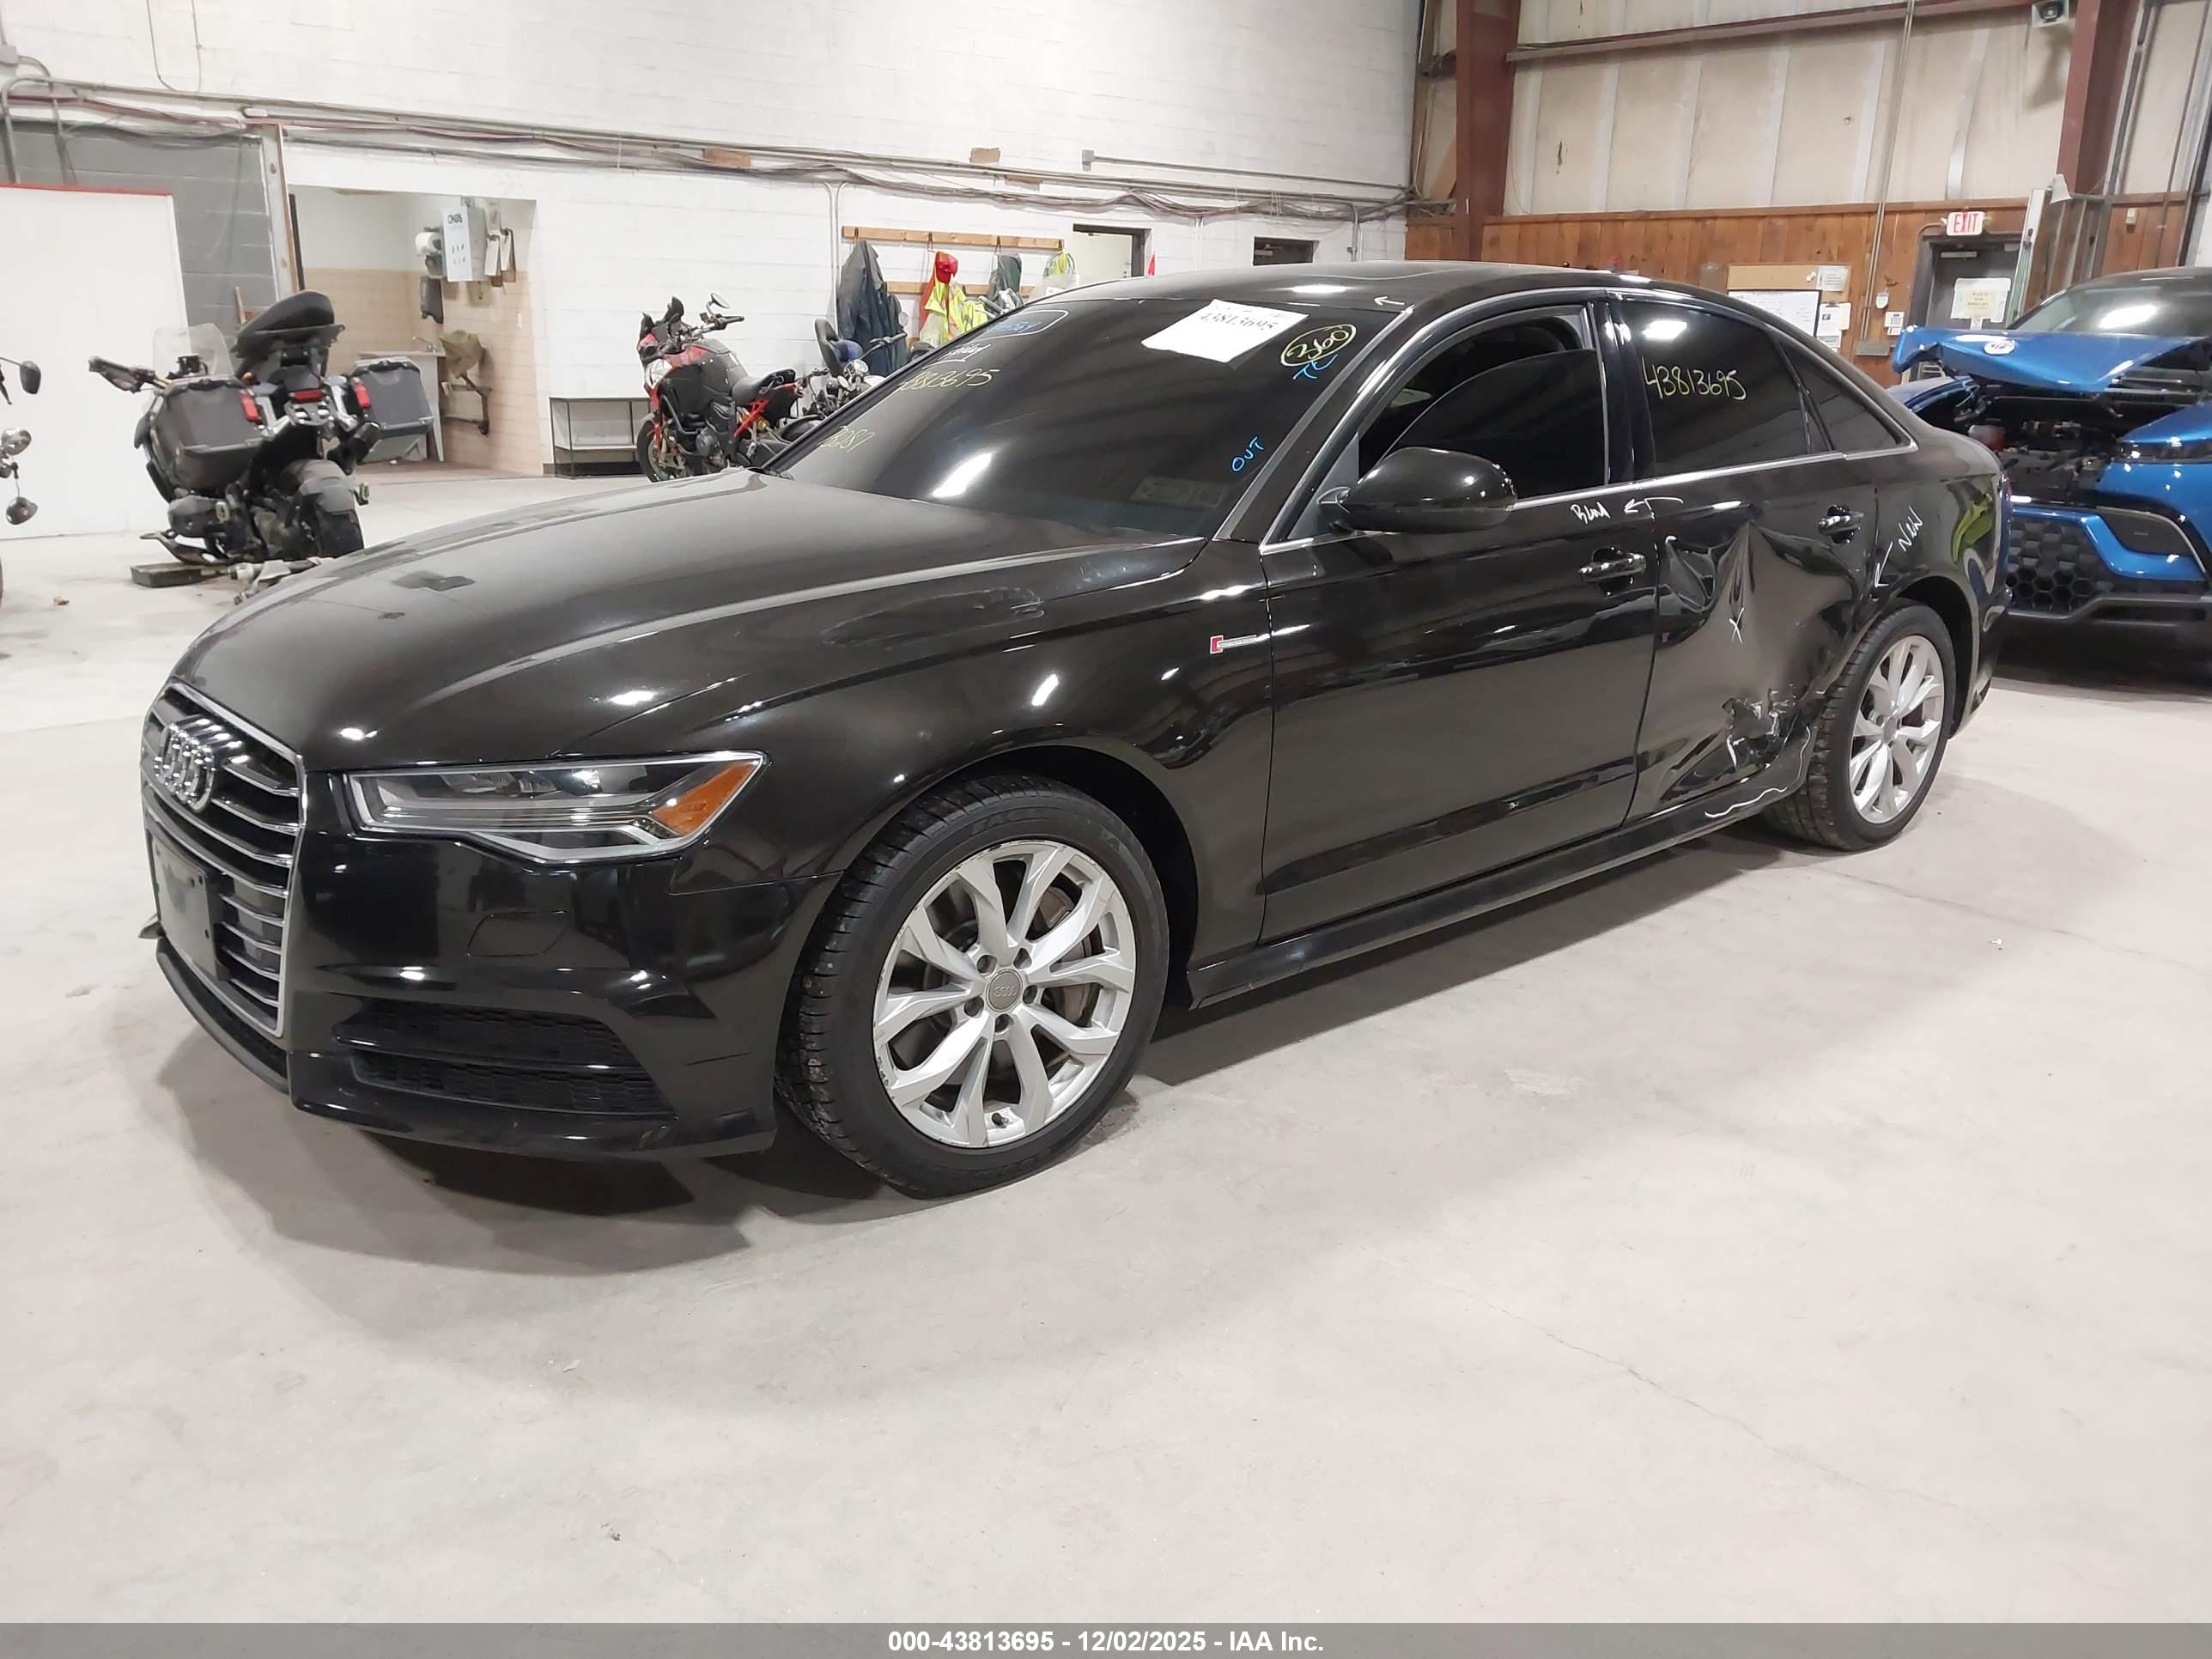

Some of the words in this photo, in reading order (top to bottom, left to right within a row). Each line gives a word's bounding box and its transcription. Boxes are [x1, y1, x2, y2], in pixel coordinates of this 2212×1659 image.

[1953, 213, 1978, 234] EXIT
[1641, 356, 1747, 400] 43813695
[1231, 436, 1265, 471] OUT
